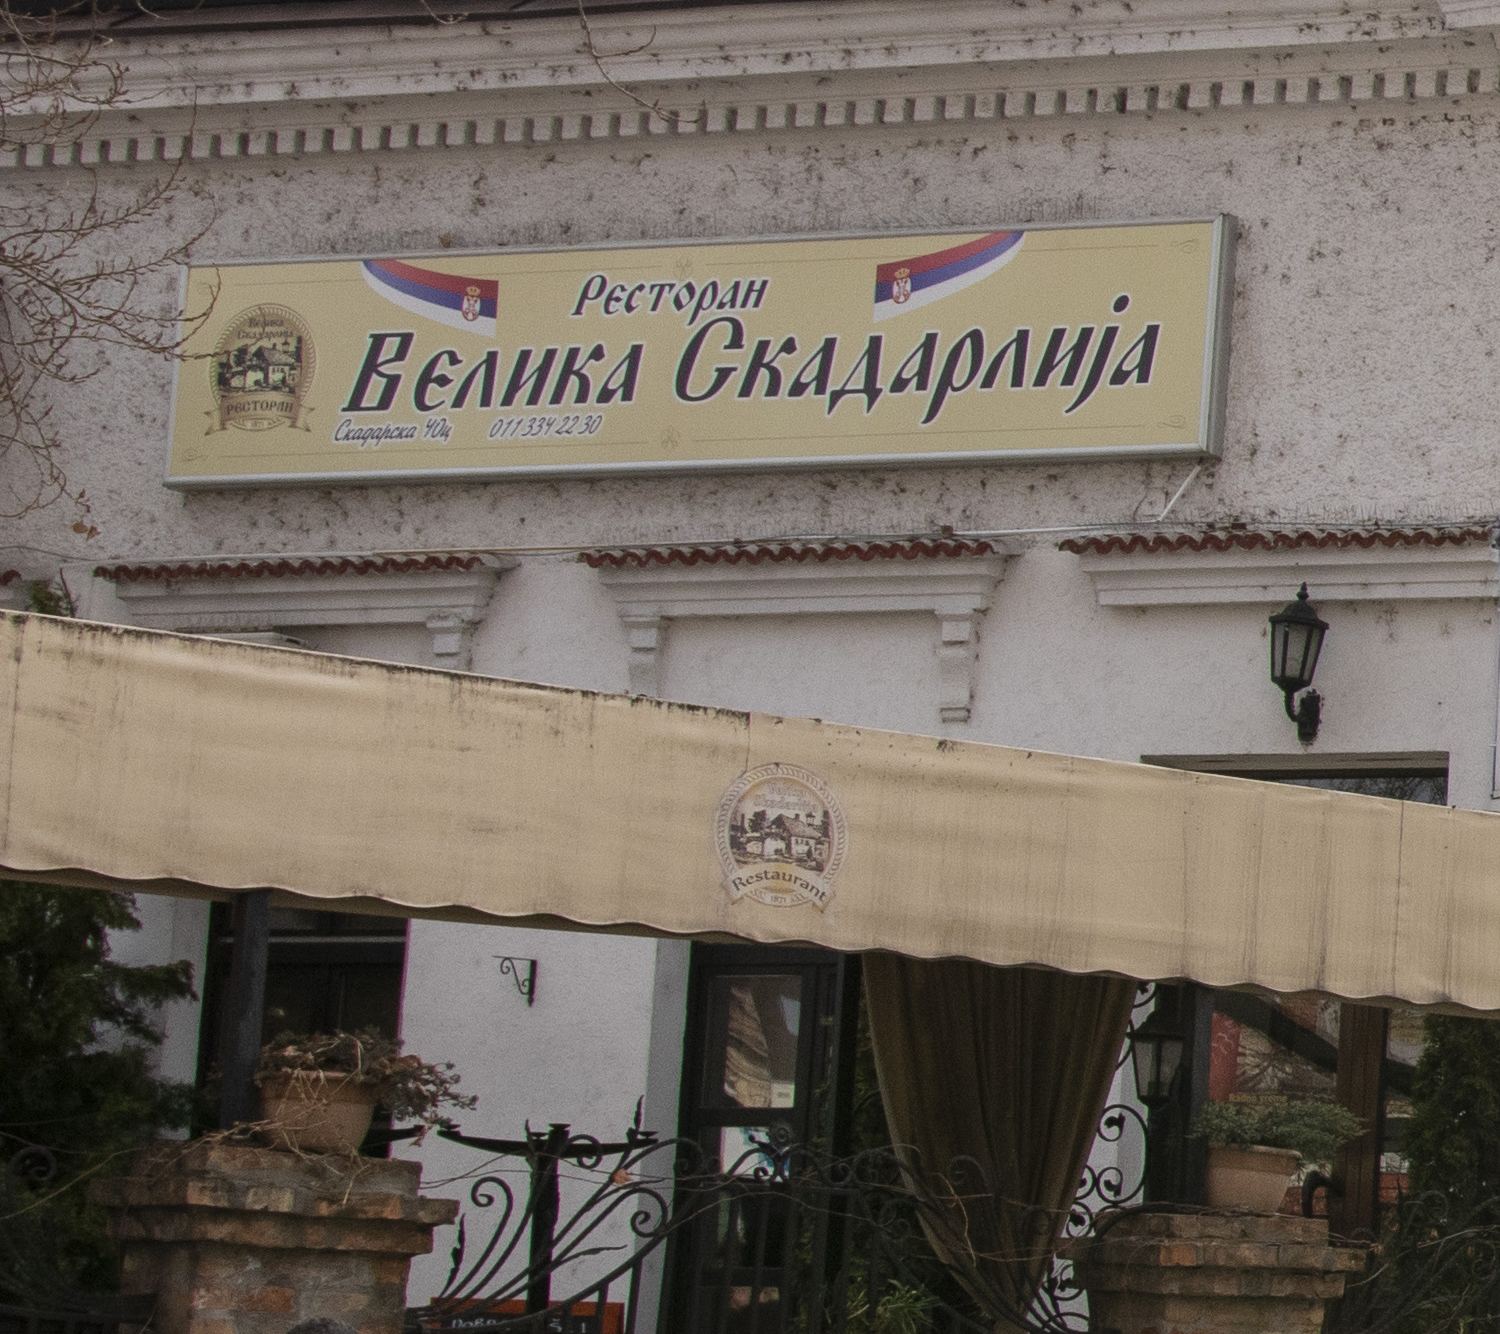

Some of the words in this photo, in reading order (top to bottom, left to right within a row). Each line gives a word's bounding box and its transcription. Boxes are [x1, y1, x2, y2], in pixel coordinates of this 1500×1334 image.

[340, 330, 645, 414] Велика
[673, 294, 1160, 425] Скадарлија
[334, 418, 418, 448] Скадарска
[732, 868, 828, 901] Restaurant
